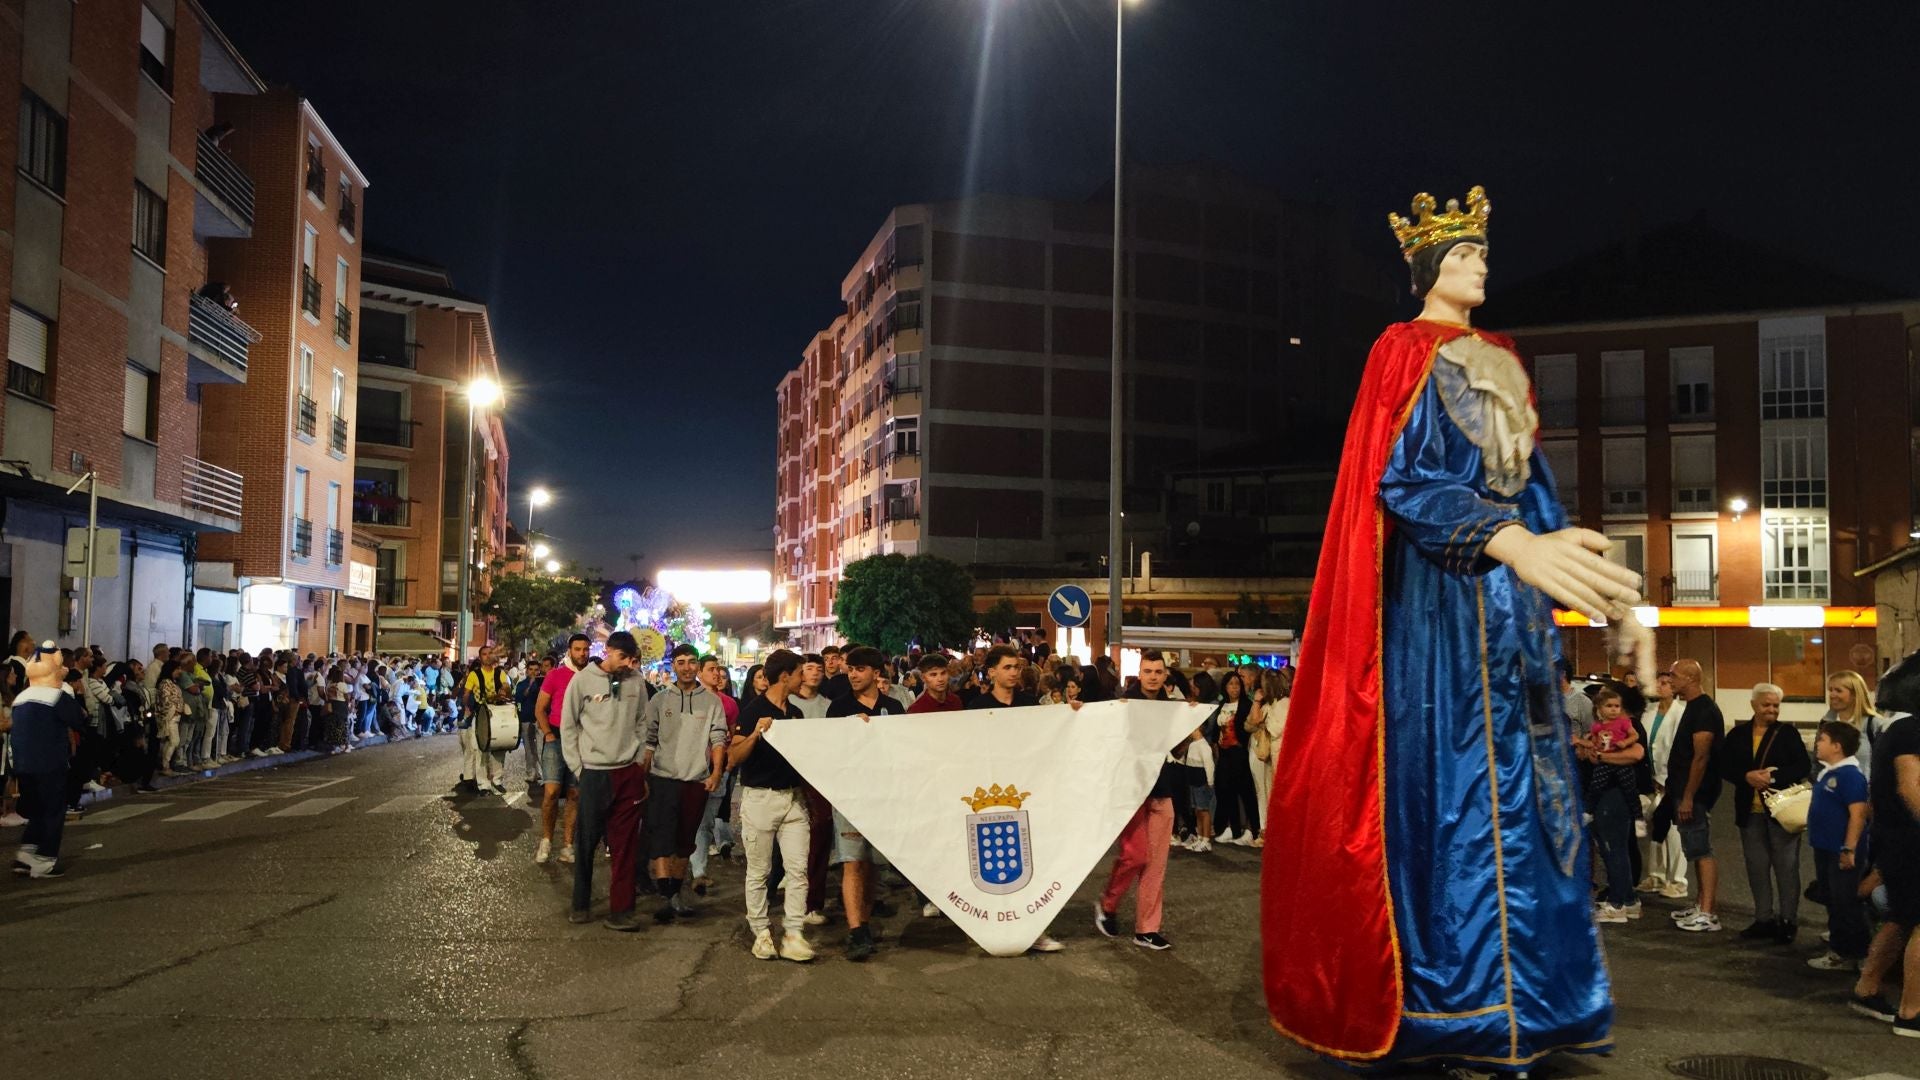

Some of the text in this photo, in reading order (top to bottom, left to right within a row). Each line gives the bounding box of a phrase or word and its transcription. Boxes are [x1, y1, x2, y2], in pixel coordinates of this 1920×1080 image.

[947, 881, 1062, 922] MEDINA DEL CAMPO
